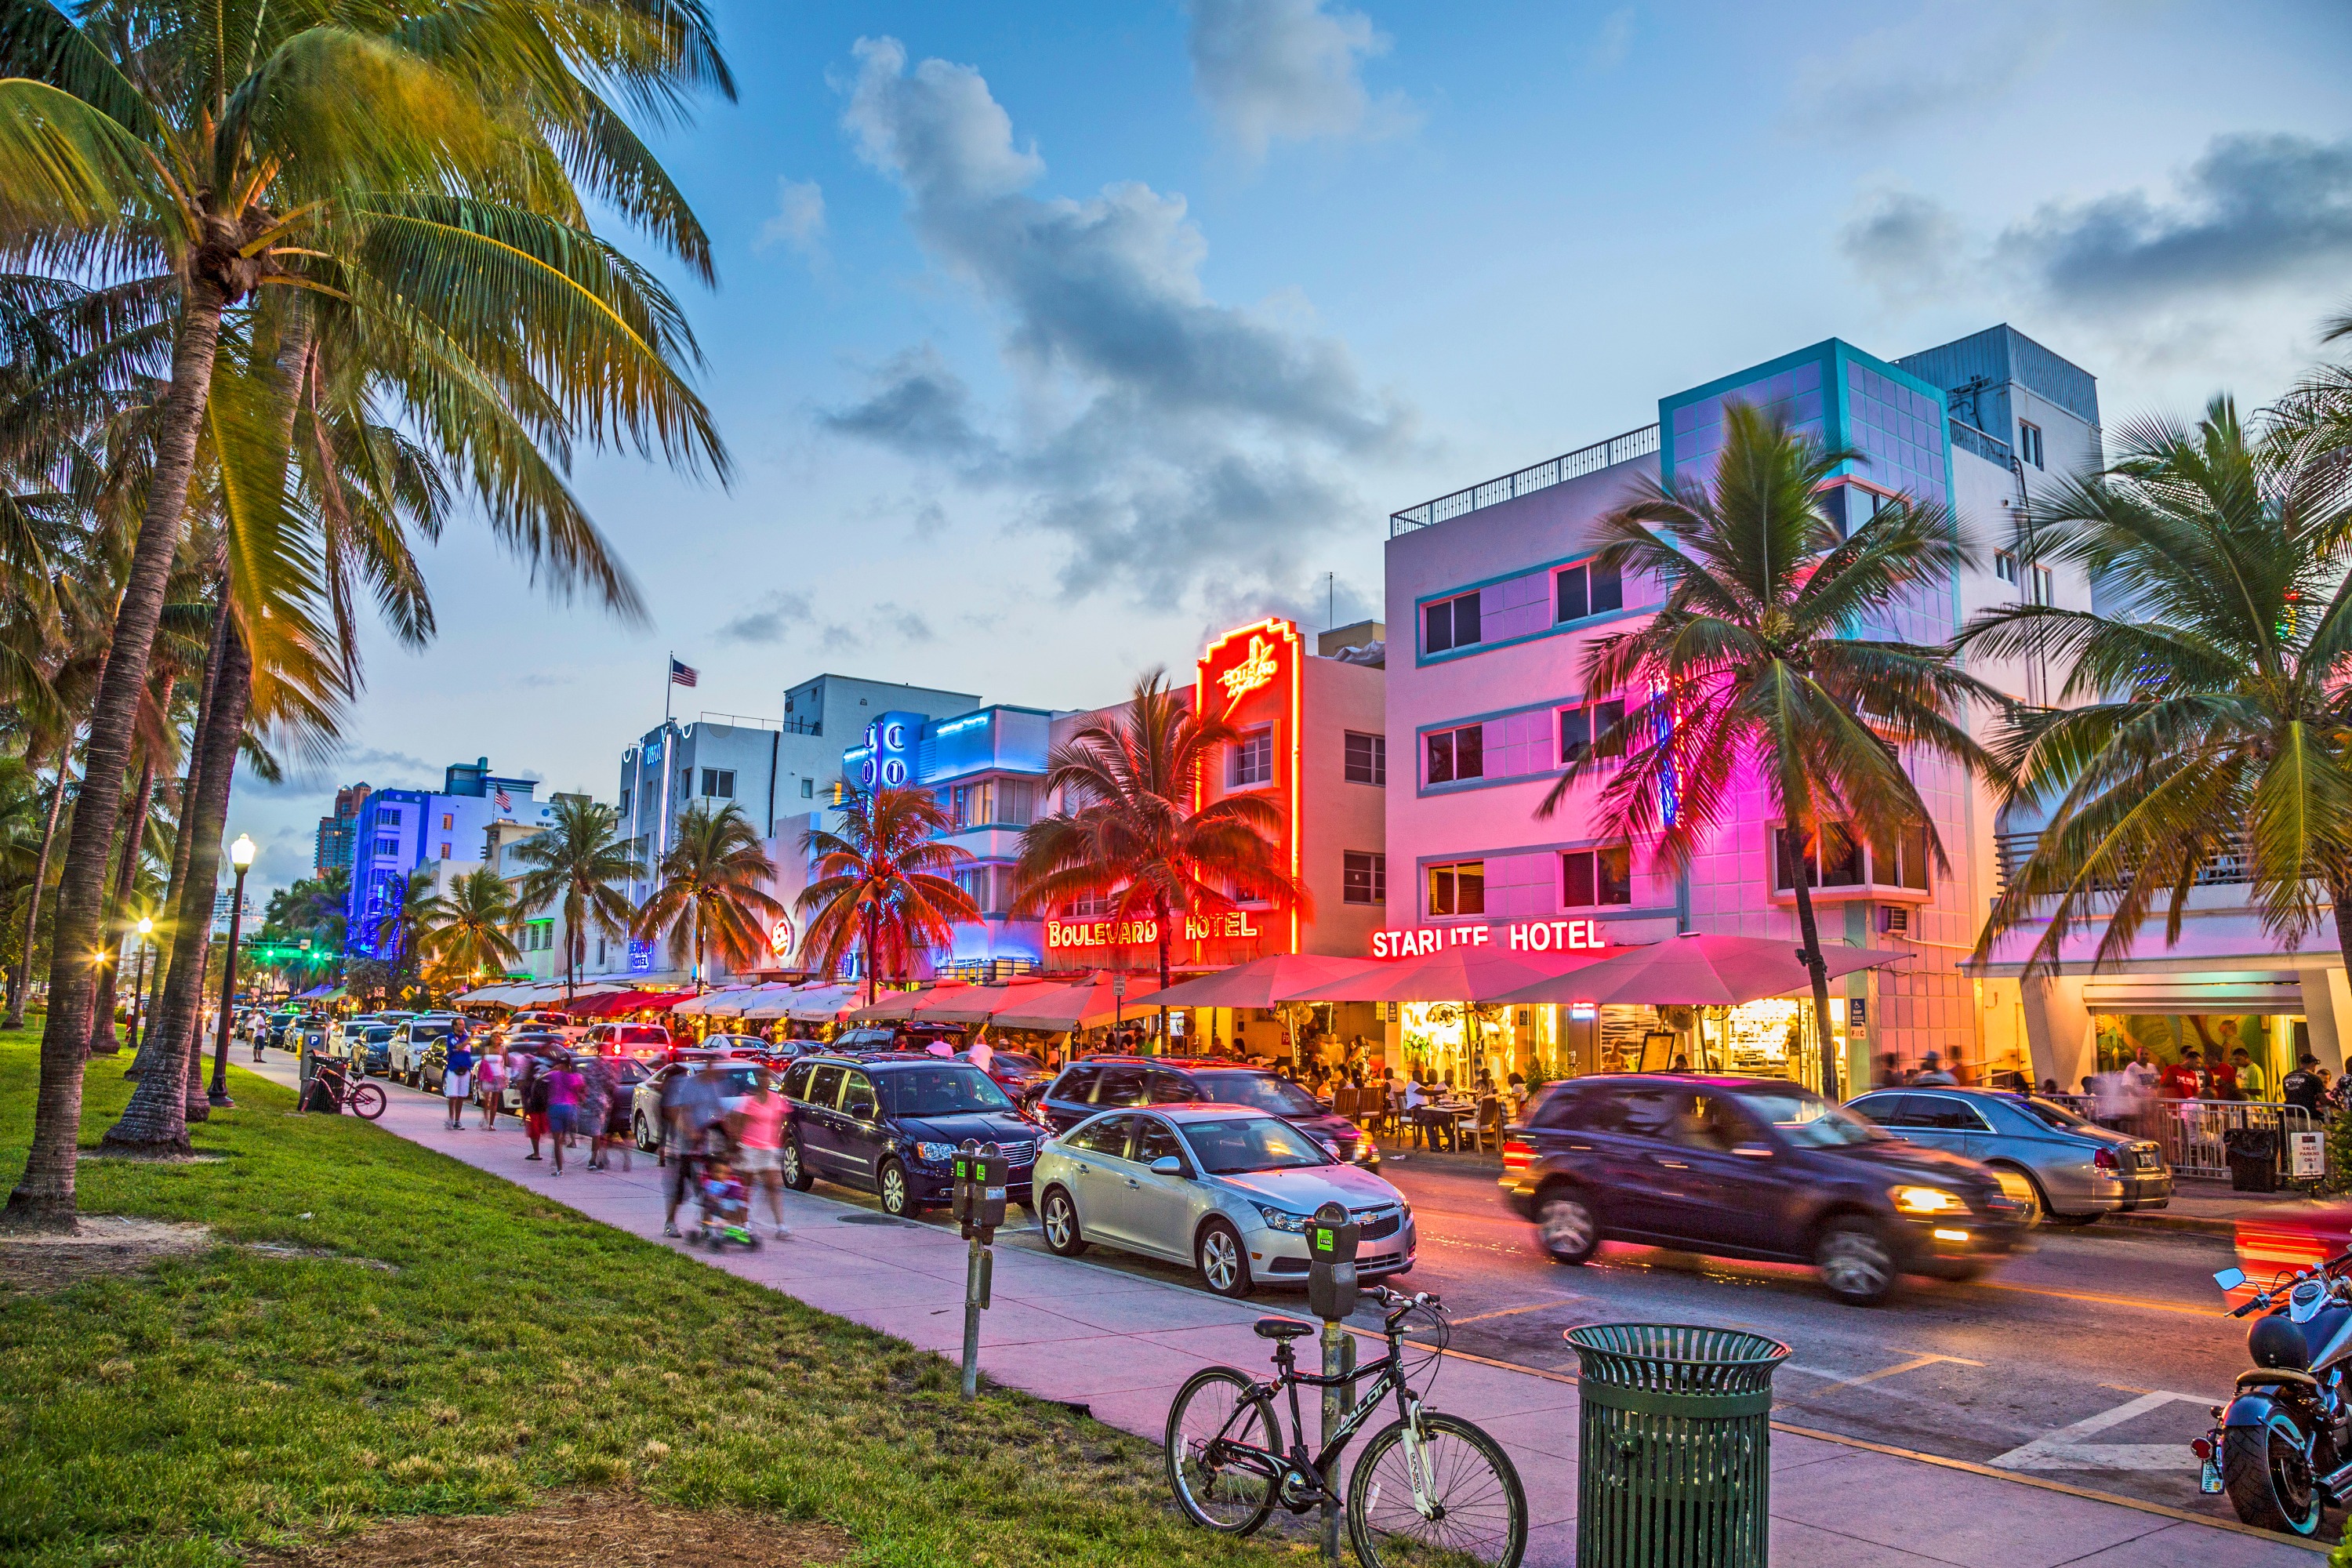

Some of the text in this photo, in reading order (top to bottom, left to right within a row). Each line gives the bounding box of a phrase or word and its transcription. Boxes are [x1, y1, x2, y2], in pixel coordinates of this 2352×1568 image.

[1047, 911, 1258, 947] BOULEVARD HOTEL
[1373, 920, 1606, 957] STARLITE HOTEL
[310, 1036, 318, 1044] P
[1330, 1377, 1392, 1442] AVALON
[1231, 1445, 1256, 1454] AVALON
